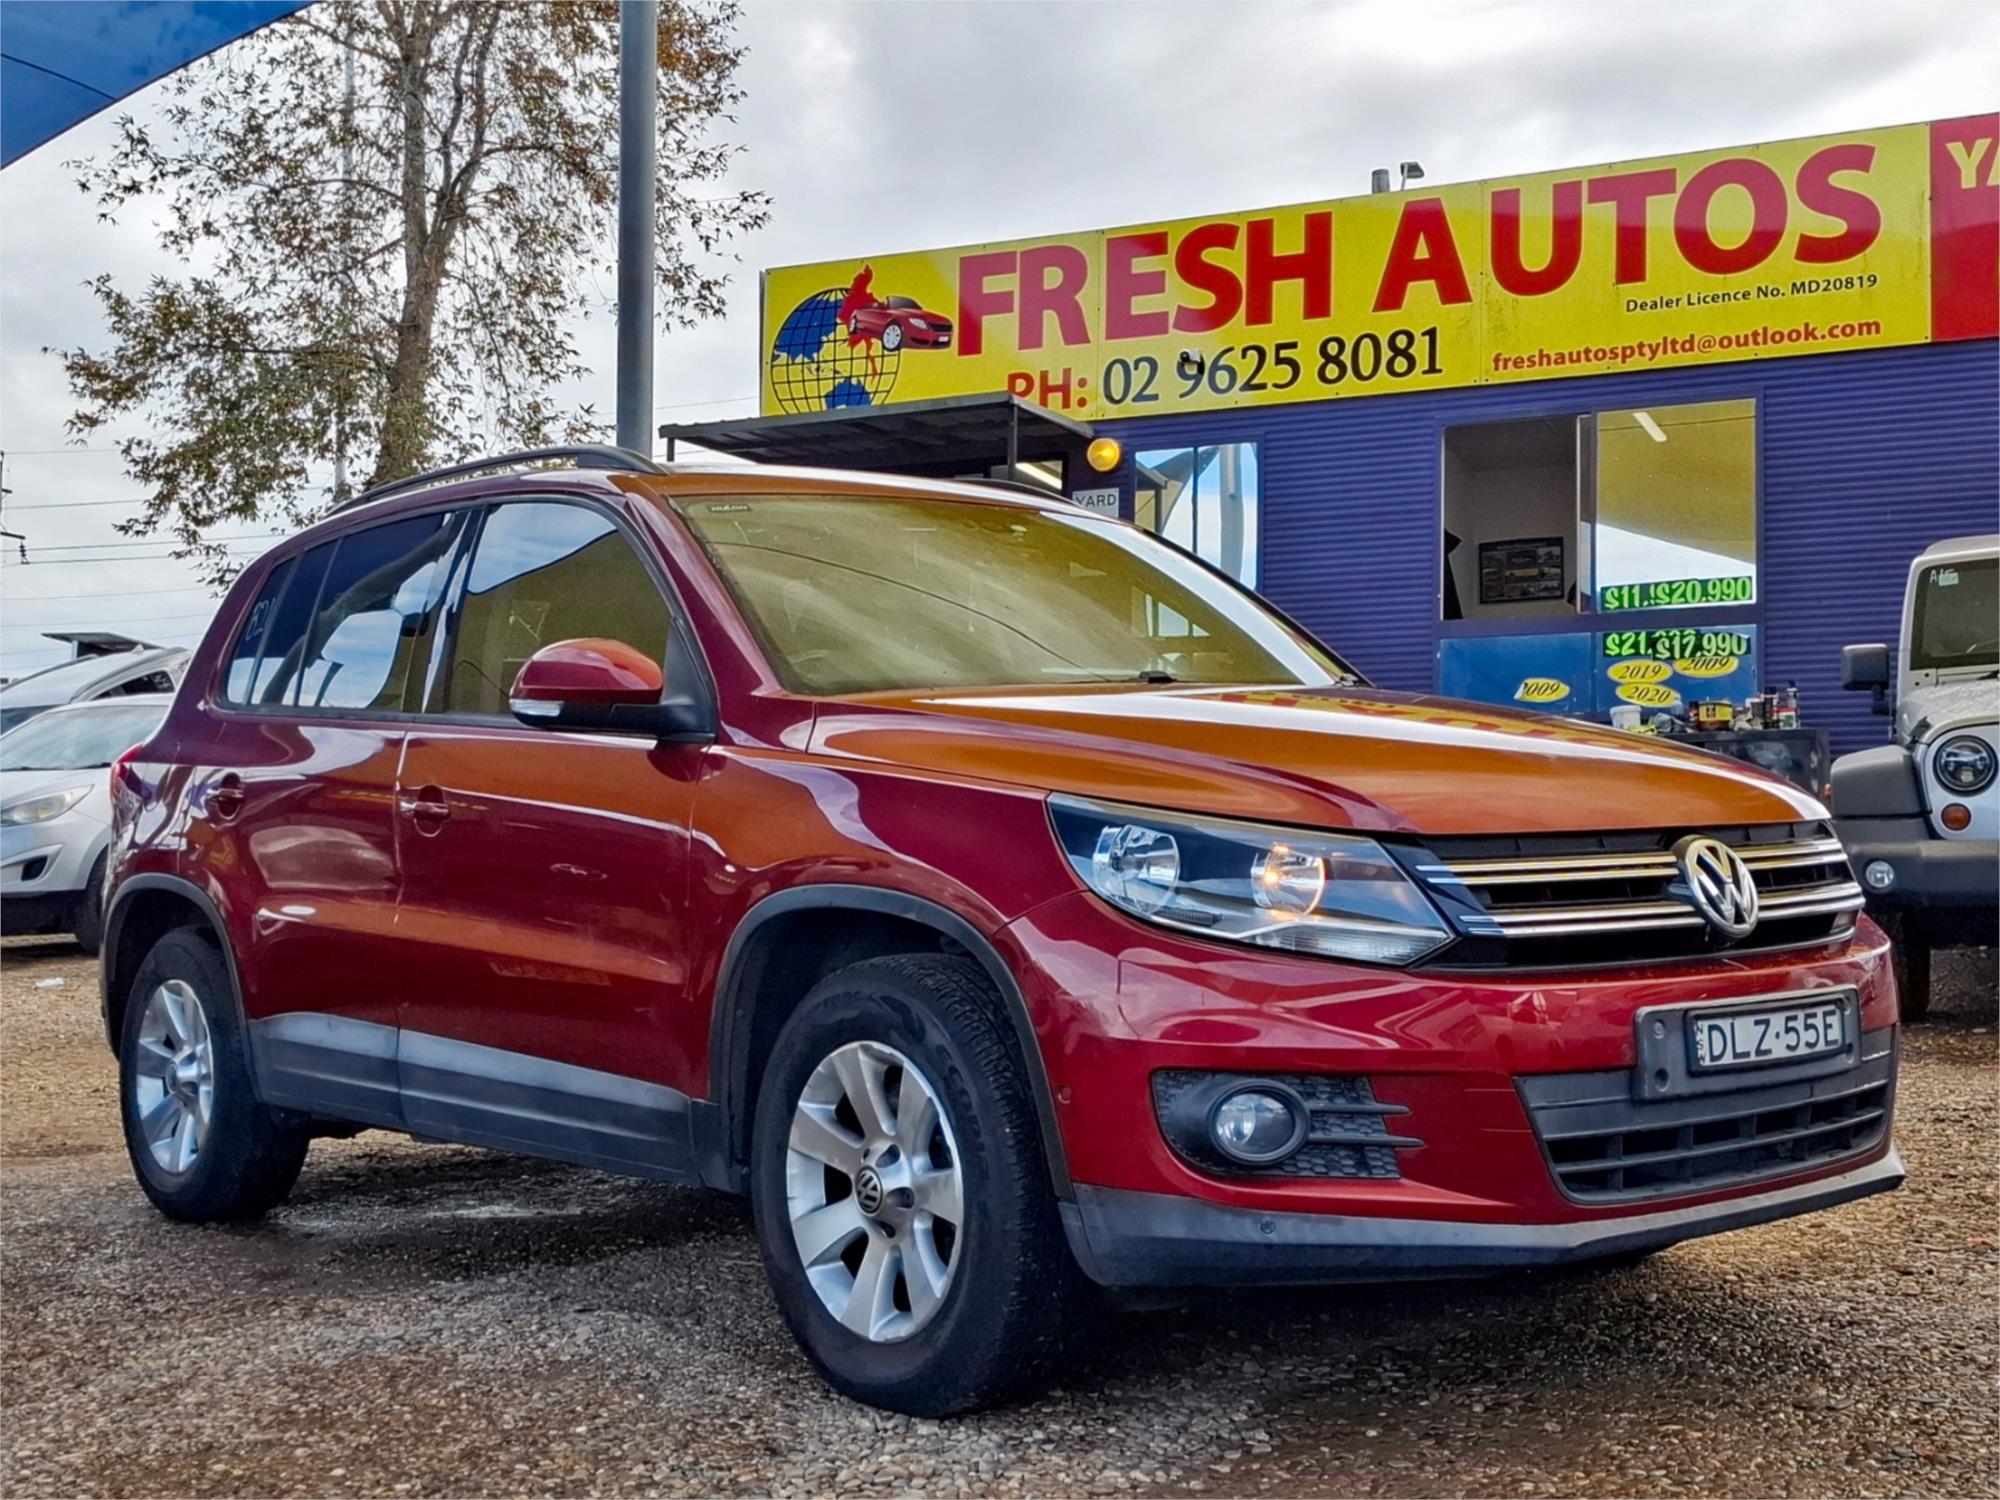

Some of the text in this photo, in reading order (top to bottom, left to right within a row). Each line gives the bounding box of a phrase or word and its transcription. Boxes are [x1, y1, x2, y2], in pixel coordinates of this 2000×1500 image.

[957, 144, 1882, 357] FRESH AUTOS
[1625, 275, 1878, 314] Dealer Licence No. MD20819
[1492, 320, 1881, 374] freshautosptyltd@outlook.com
[1007, 326, 1442, 411] PH: 02 9625 8081
[1075, 493, 1117, 507] YARD
[1619, 664, 1662, 679] 2019
[1626, 685, 1671, 703] 2020
